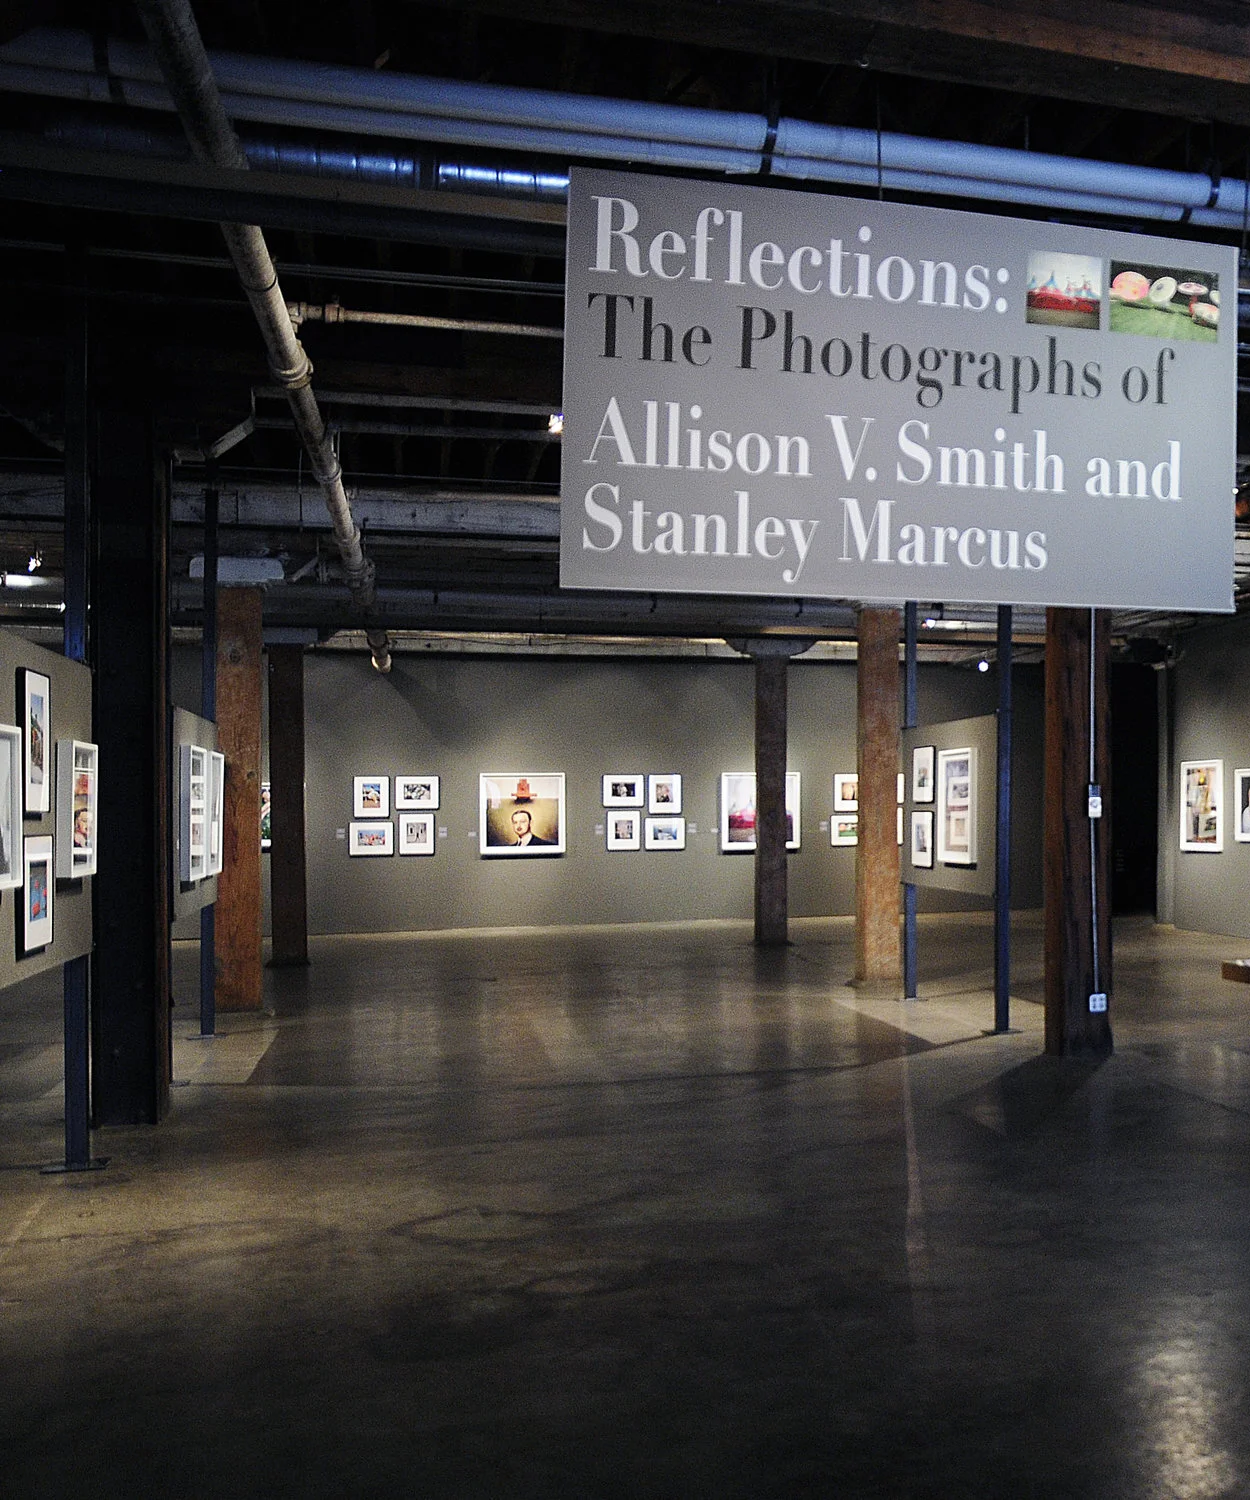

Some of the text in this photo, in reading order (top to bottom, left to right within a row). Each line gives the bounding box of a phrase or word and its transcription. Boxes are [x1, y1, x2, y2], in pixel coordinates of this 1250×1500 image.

[588, 195, 1009, 313] Reflections:
[588, 292, 1175, 414] The Photographs of
[583, 396, 1181, 500] Allison V. Smith and
[583, 482, 1048, 583] Stanley Marcus
